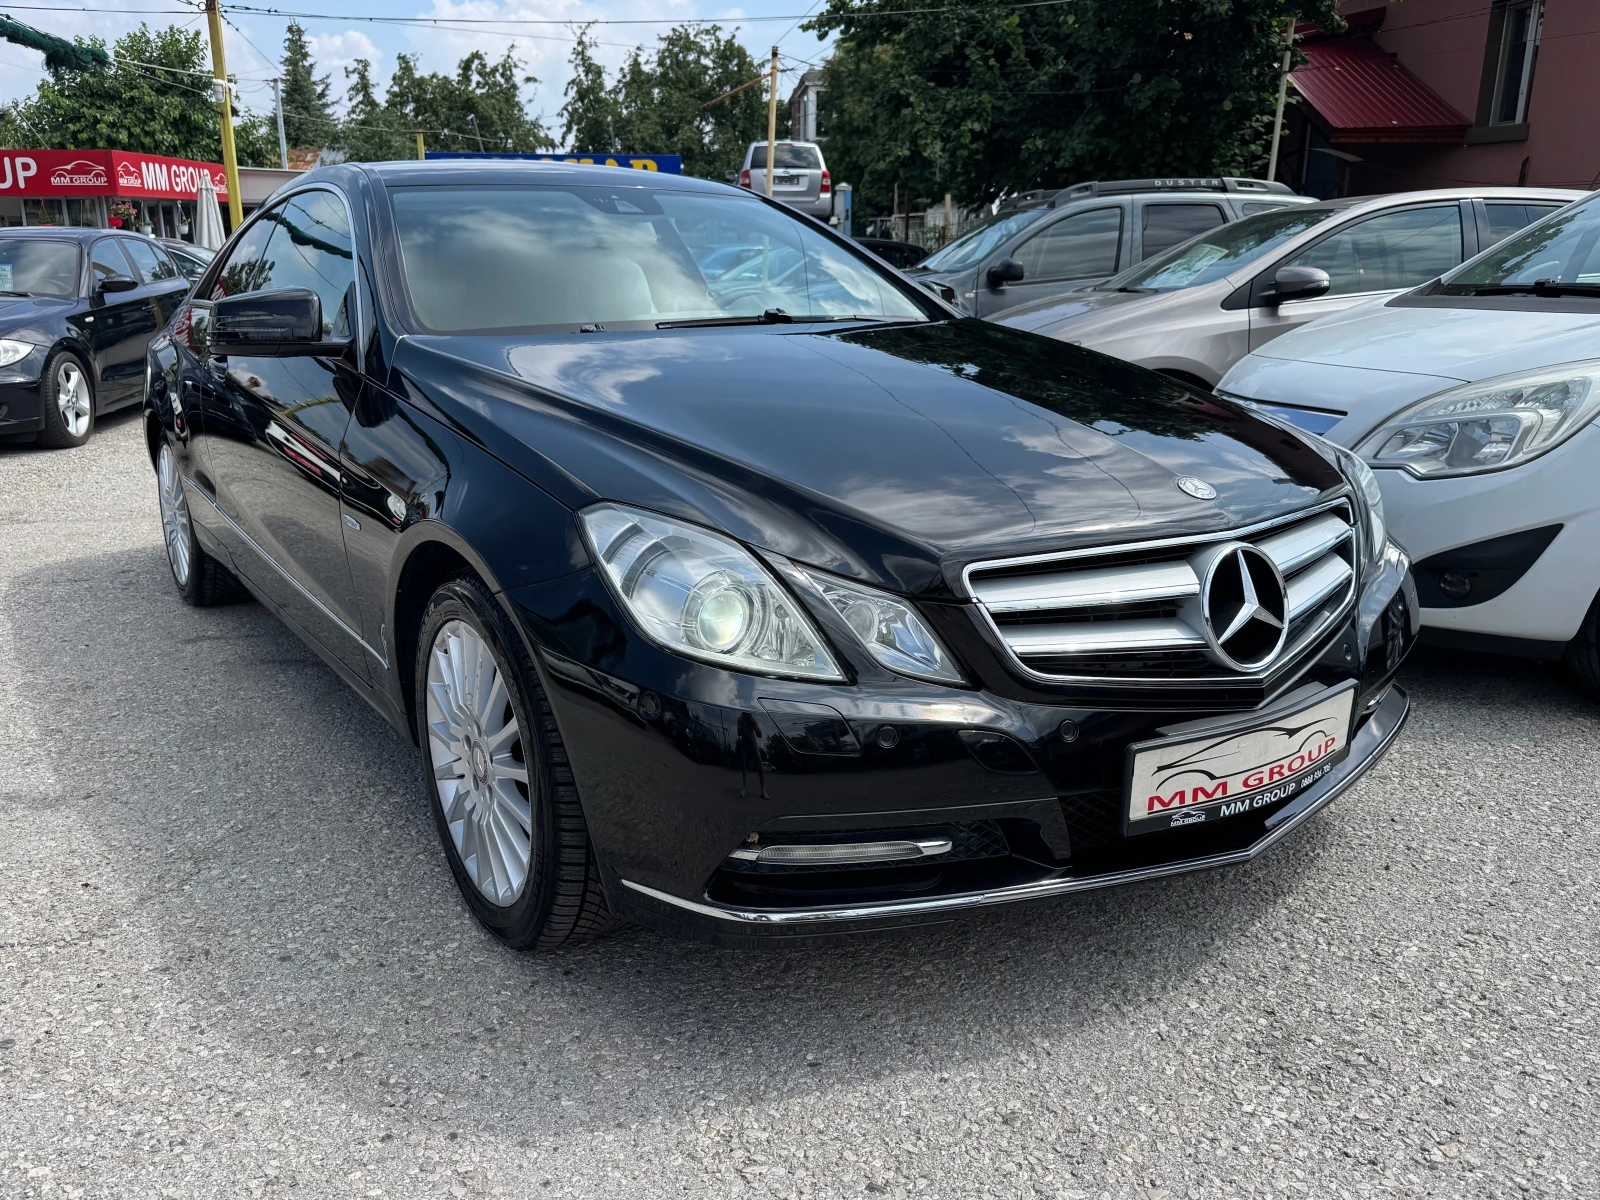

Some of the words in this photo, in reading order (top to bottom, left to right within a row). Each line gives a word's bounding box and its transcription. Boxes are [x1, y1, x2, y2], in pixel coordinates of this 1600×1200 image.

[51, 176, 71, 184] MM
[73, 176, 107, 184] GROUP
[141, 161, 169, 191] MM
[1147, 781, 1228, 812] MM
[1242, 737, 1336, 789] GROUP
[1220, 802, 1249, 817] MM
[1253, 783, 1295, 807] GROUP
